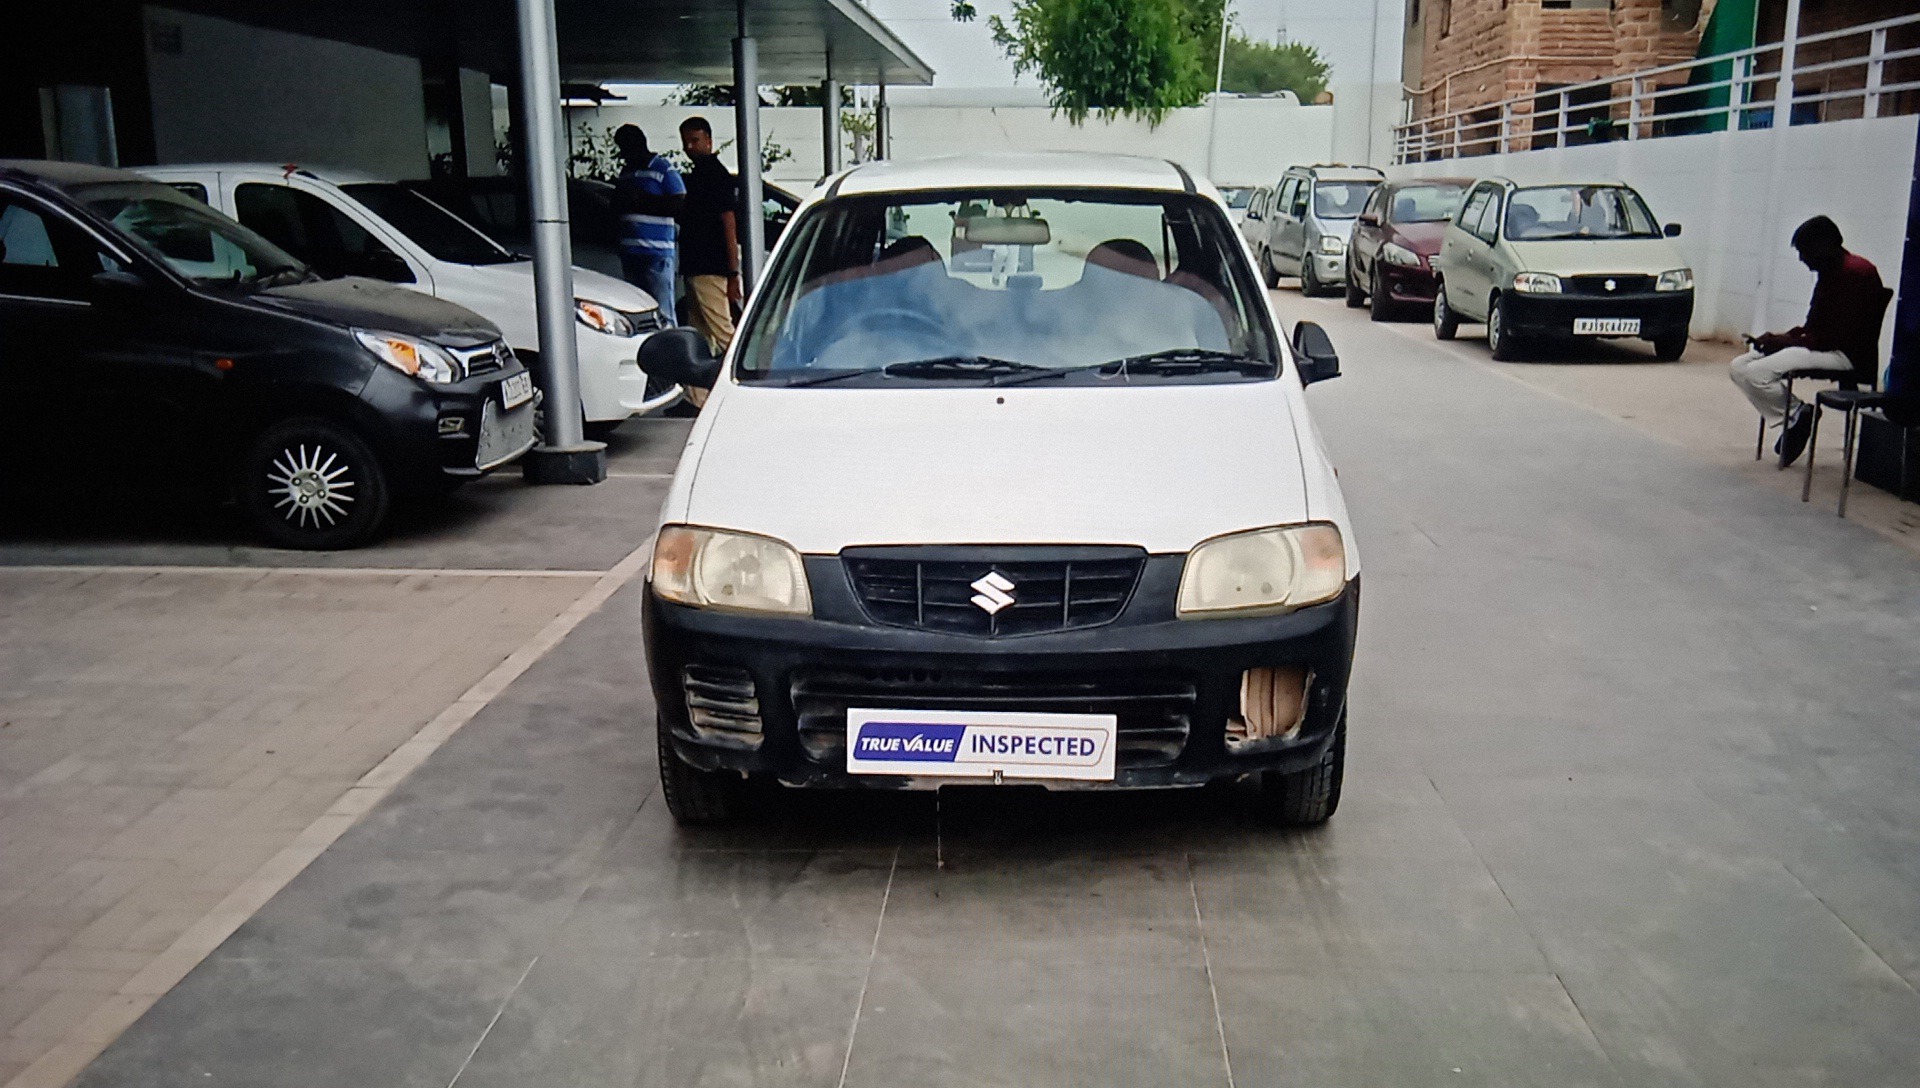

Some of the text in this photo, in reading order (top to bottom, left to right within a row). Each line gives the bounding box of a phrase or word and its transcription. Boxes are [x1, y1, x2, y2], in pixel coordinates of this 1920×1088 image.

[861, 733, 1096, 756] TRUE VALUE INSPECTED
